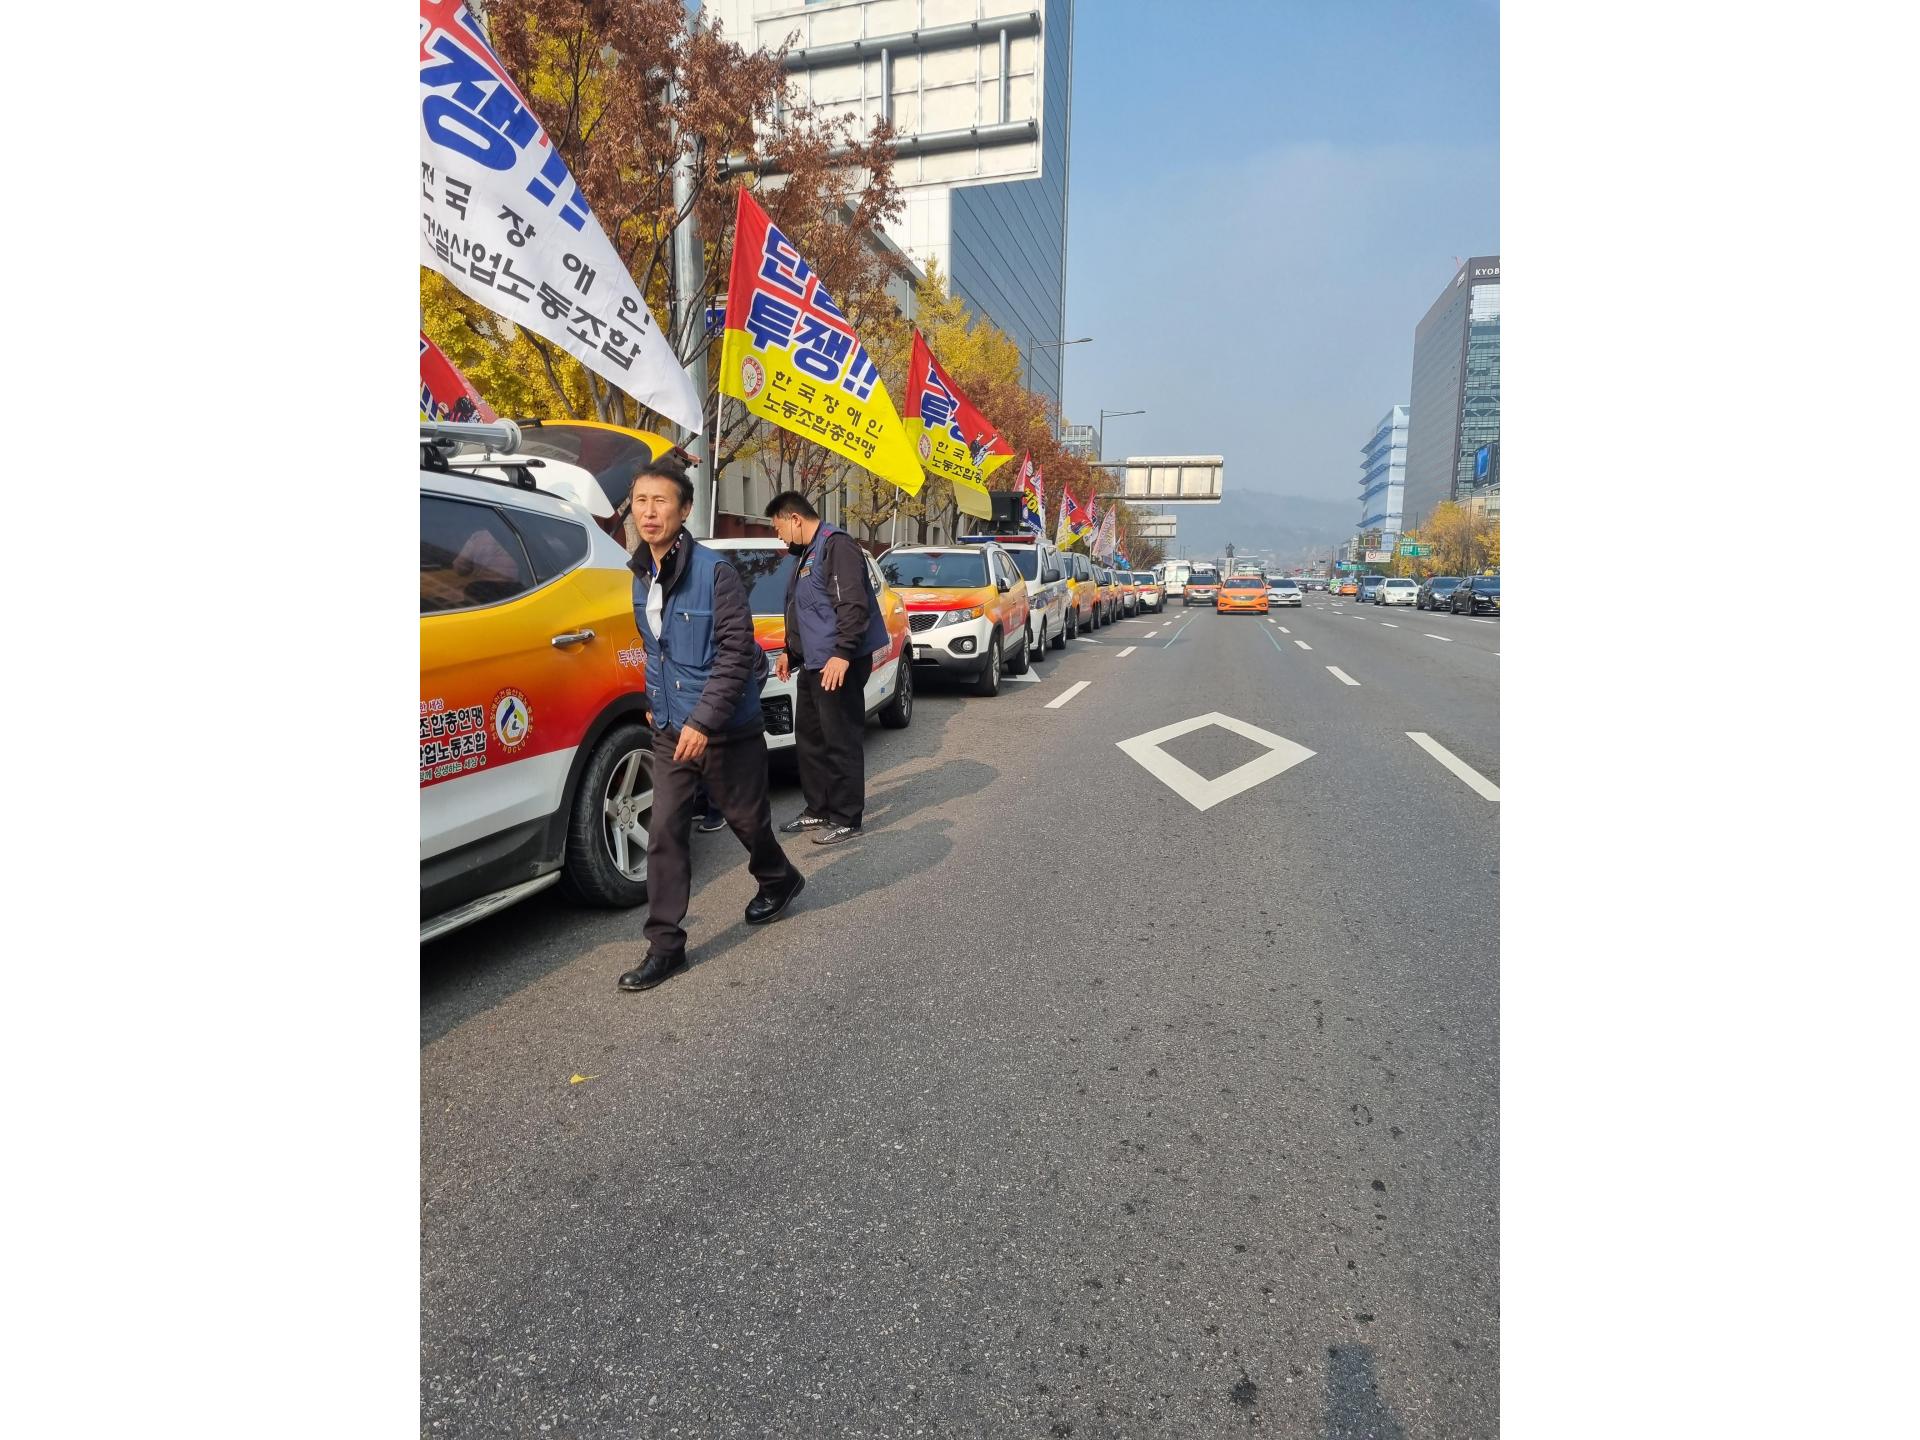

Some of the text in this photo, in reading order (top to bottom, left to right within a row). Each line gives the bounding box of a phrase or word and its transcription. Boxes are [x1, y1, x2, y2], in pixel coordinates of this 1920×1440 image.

[423, 213, 642, 371] 건설산업노동조합
[747, 290, 879, 400] 투쟁!!
[763, 393, 876, 459] 노동조합총연맹
